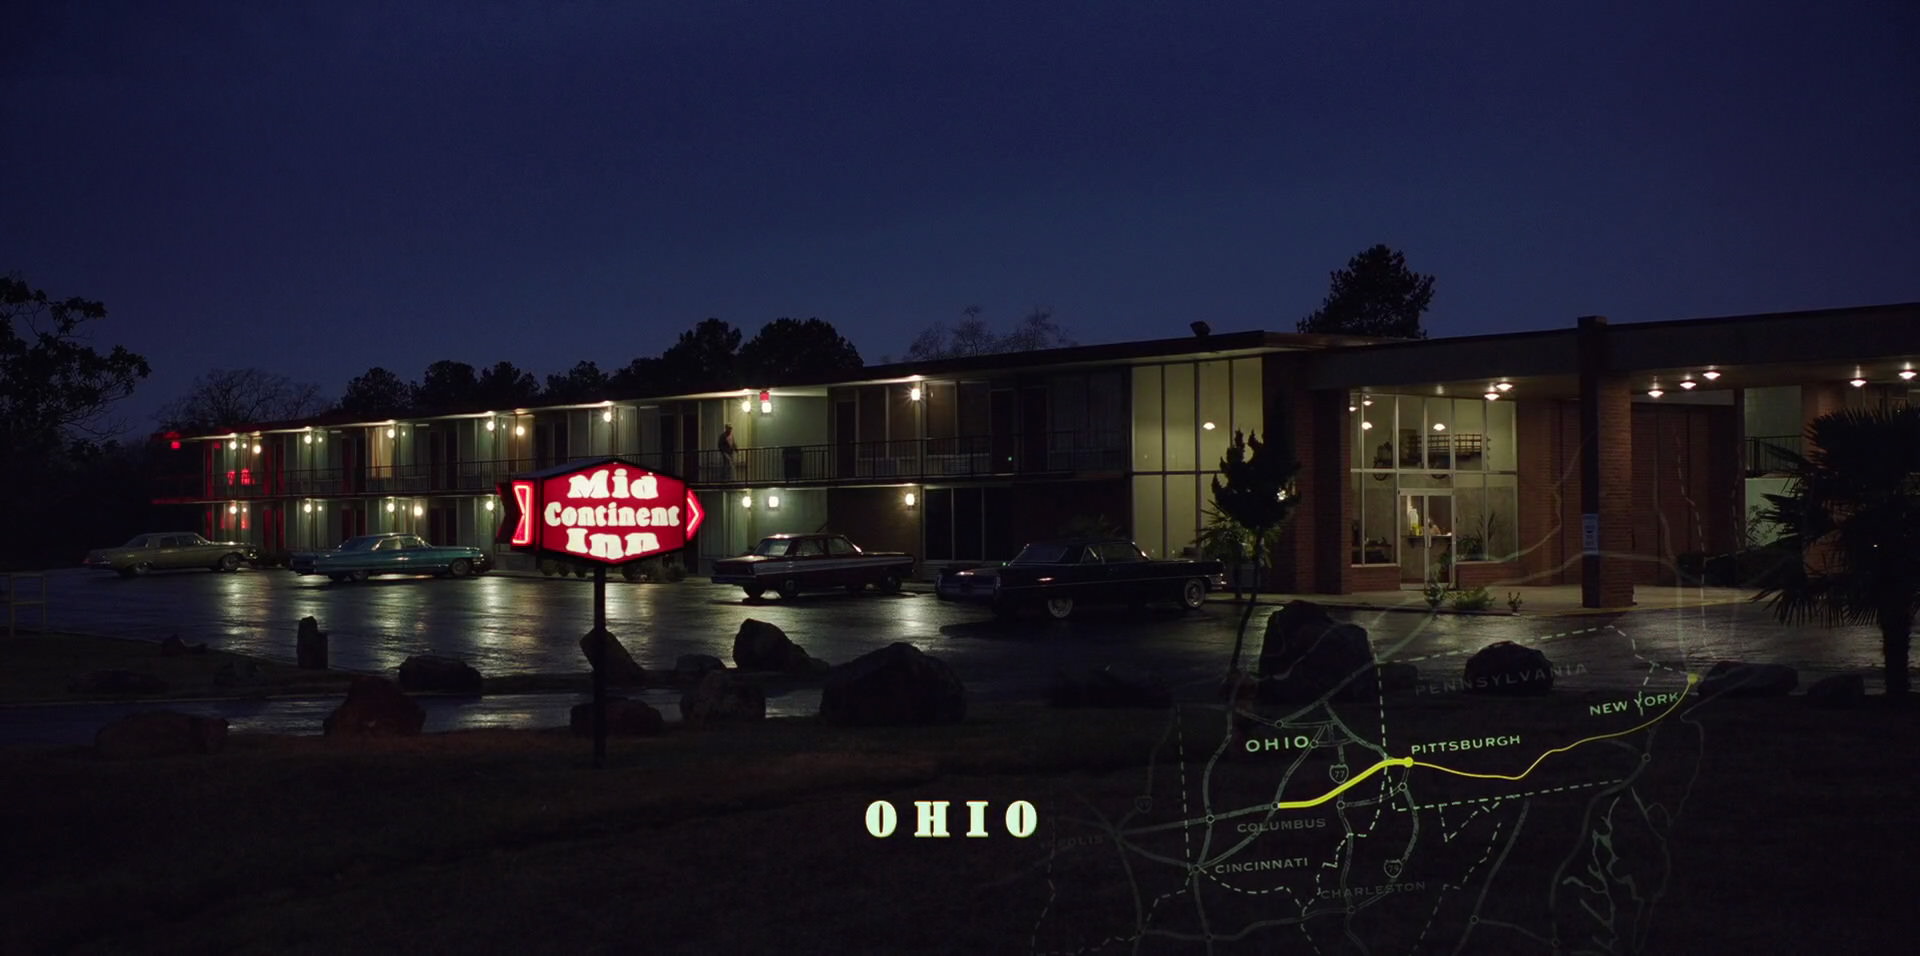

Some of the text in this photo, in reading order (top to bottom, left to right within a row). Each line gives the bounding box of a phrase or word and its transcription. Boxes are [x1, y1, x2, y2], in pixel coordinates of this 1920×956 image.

[567, 468, 659, 499] Mid
[544, 501, 680, 527] Continent
[566, 528, 660, 560] Inn
